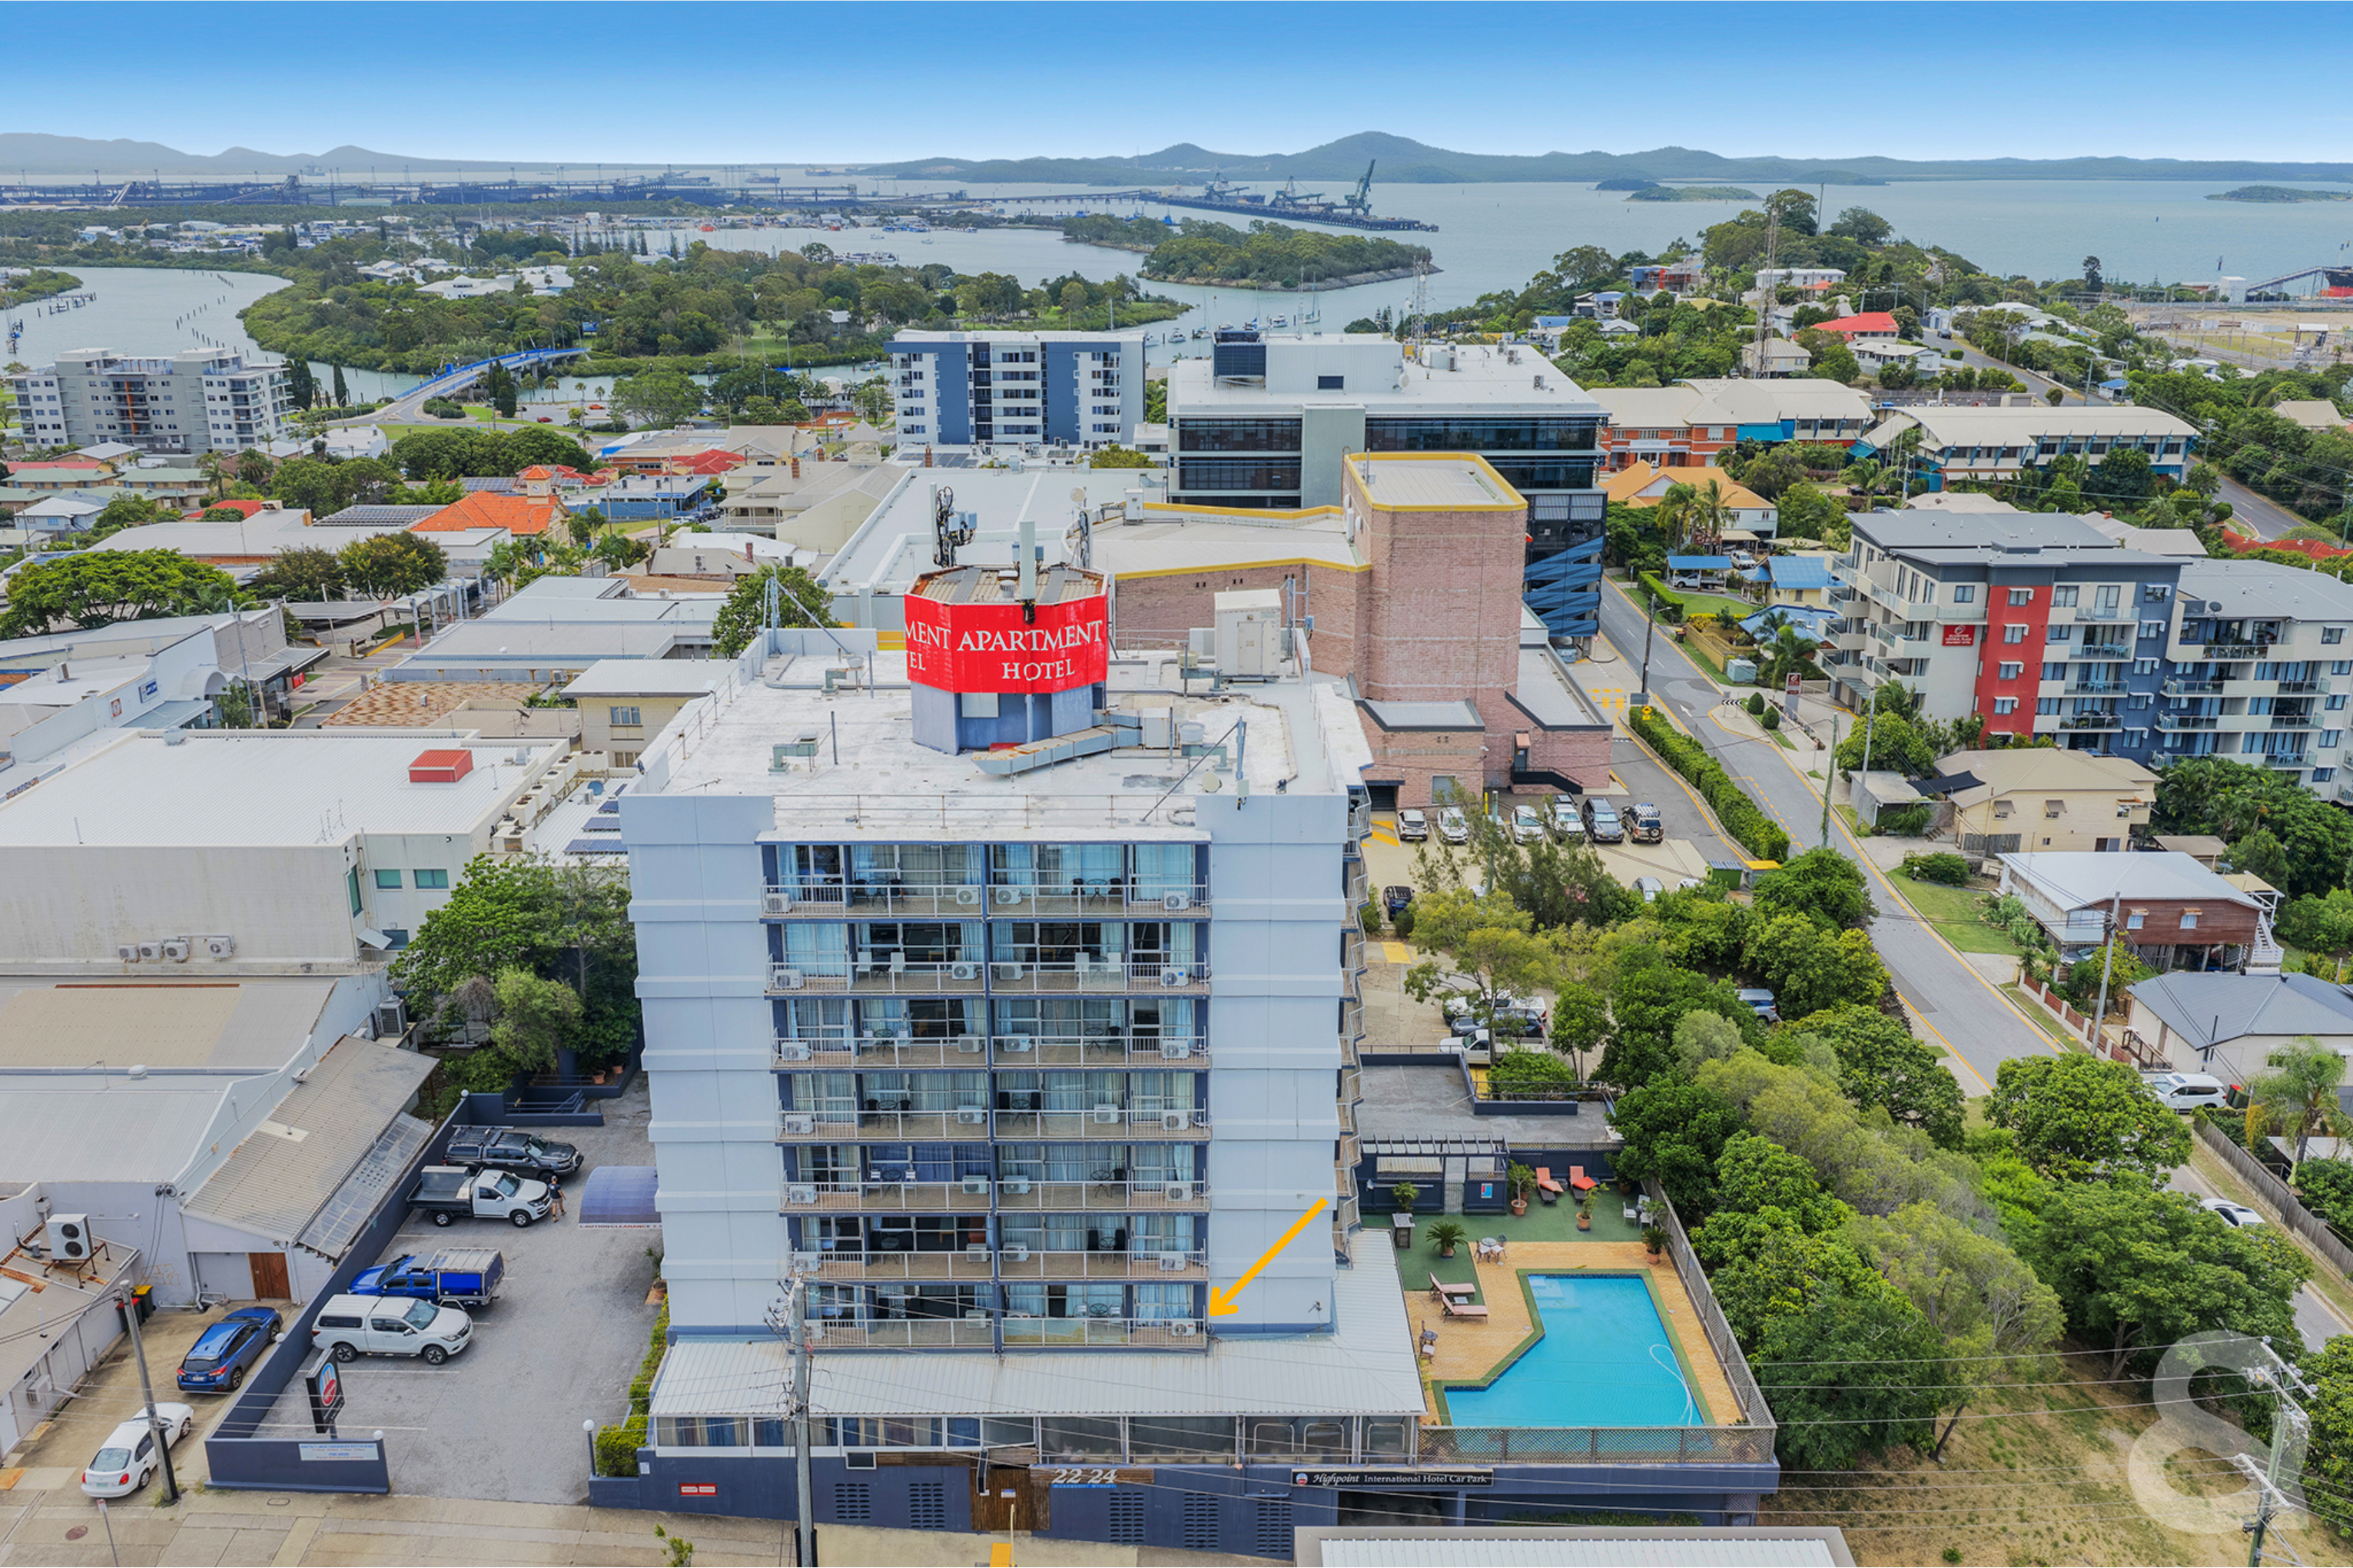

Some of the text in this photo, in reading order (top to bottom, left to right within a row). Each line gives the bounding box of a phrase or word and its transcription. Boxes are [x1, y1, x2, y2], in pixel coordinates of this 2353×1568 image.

[957, 620, 1103, 651] APARTMENT
[906, 650, 926, 671] EL
[1001, 658, 1075, 681] HOTEL
[1313, 1473, 1360, 1487] Highpoint
